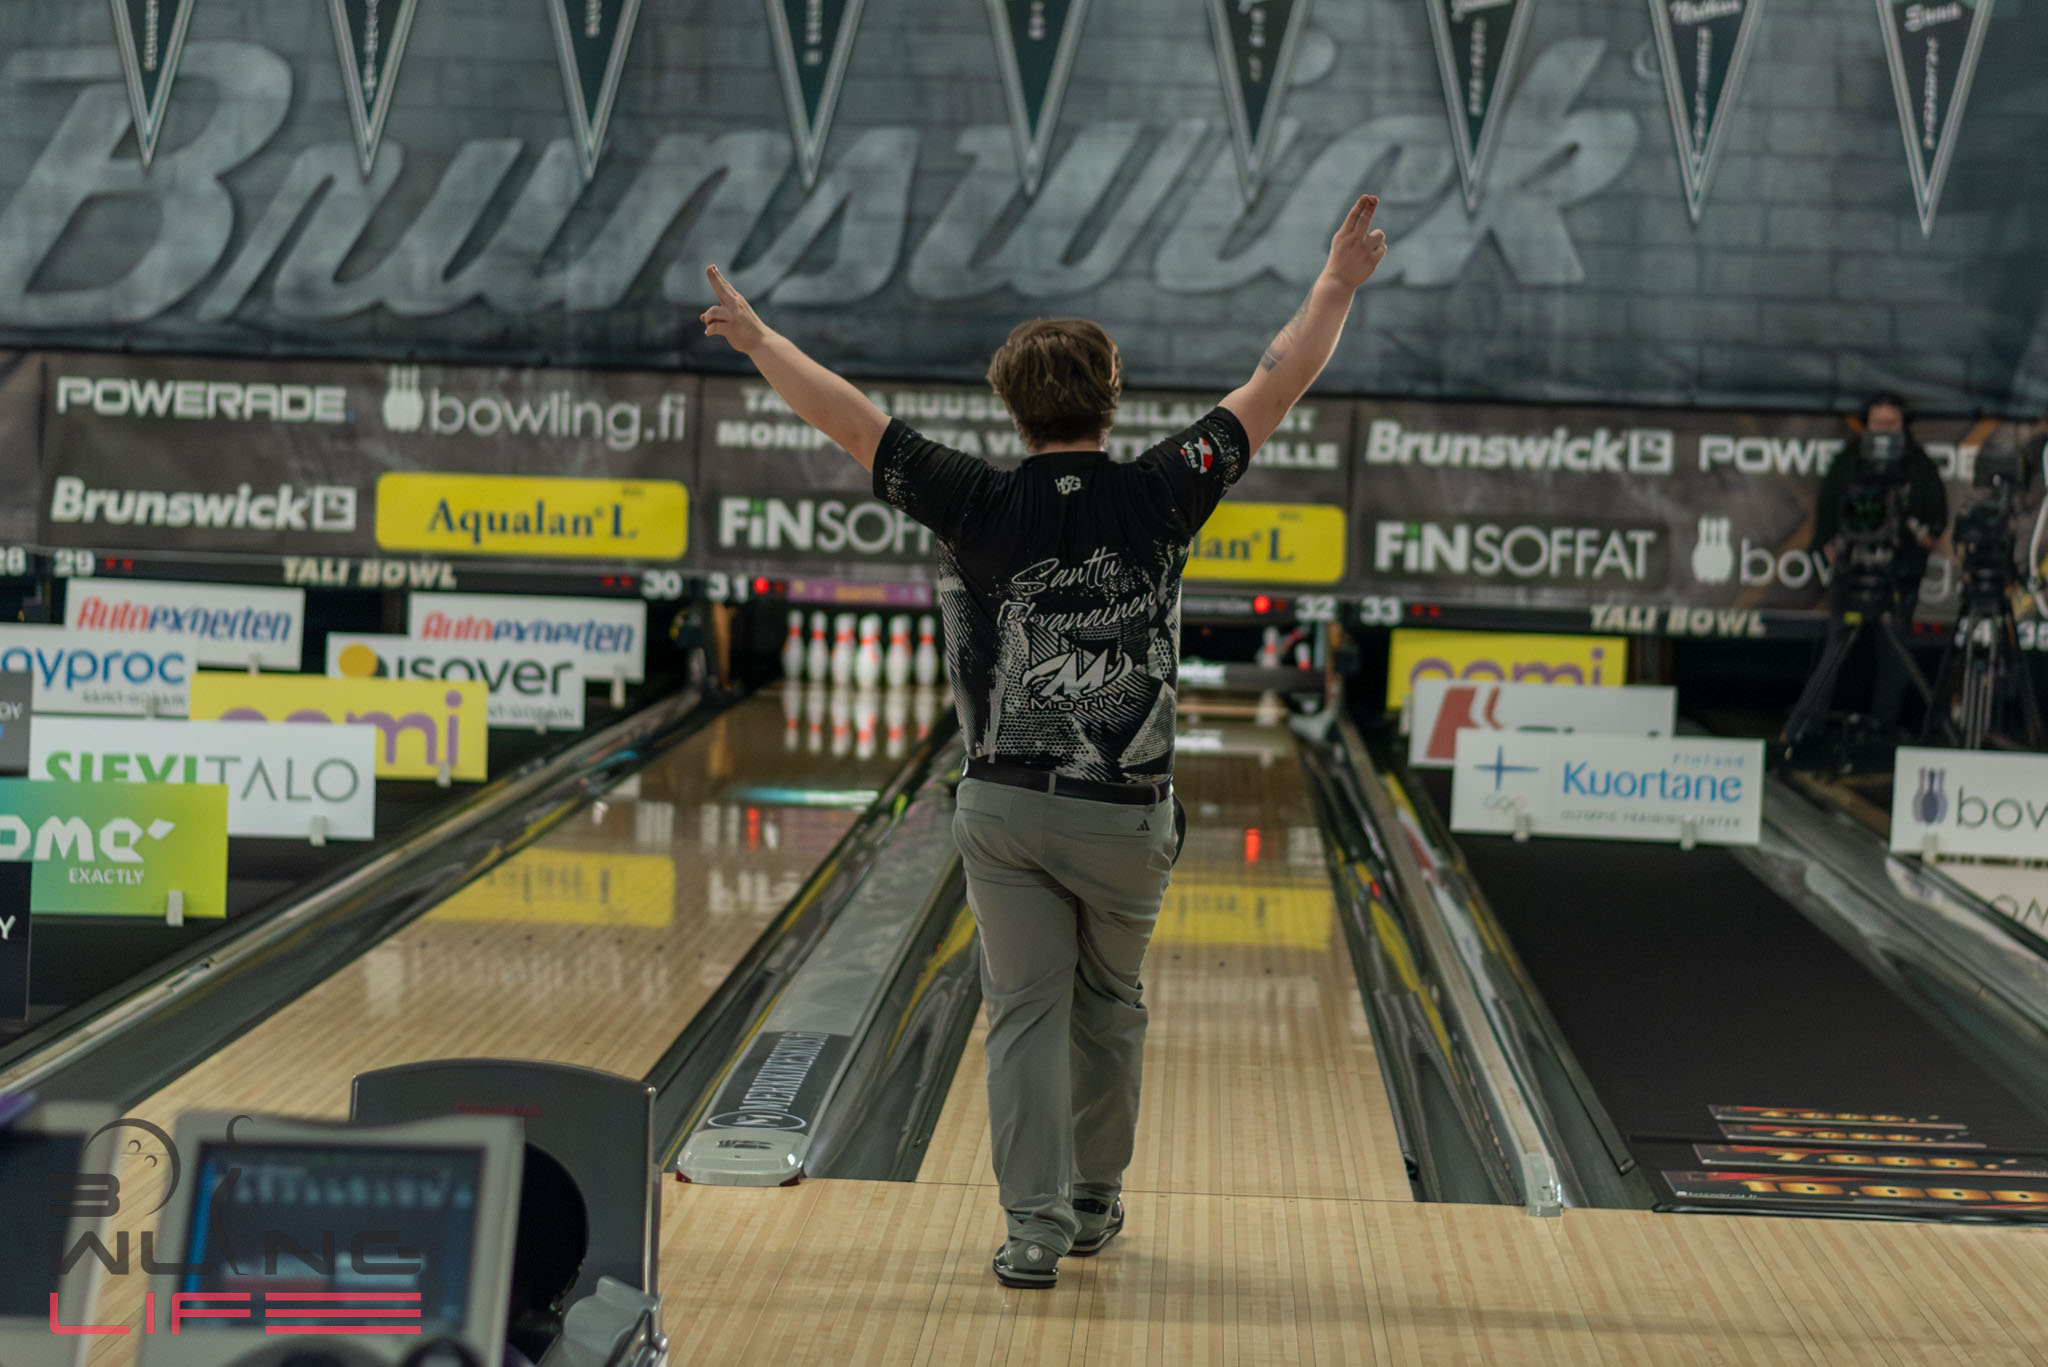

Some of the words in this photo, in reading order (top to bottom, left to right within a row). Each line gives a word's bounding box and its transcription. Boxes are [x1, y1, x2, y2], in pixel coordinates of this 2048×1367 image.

[0, 36, 1640, 326] Brunswick
[57, 376, 347, 424] POWERADE
[430, 386, 687, 450] bowling.fi
[1365, 418, 1625, 473] Brunswick
[50, 475, 307, 531] Brunswick
[283, 556, 351, 586] TALI
[357, 559, 457, 591] BOWL
[640, 569, 683, 599] 30
[706, 571, 750, 602] 31
[1011, 545, 1122, 596] Santtu
[76, 595, 292, 643] Autoexperten
[1295, 594, 1337, 622] 32
[1360, 595, 1402, 626] 33
[1589, 604, 1657, 634] TALI
[1665, 607, 1766, 639] BOWL
[1030, 691, 1127, 712] MOTIV
[1562, 760, 1743, 804] Kuortane
[69, 868, 145, 885] EXACTLY
